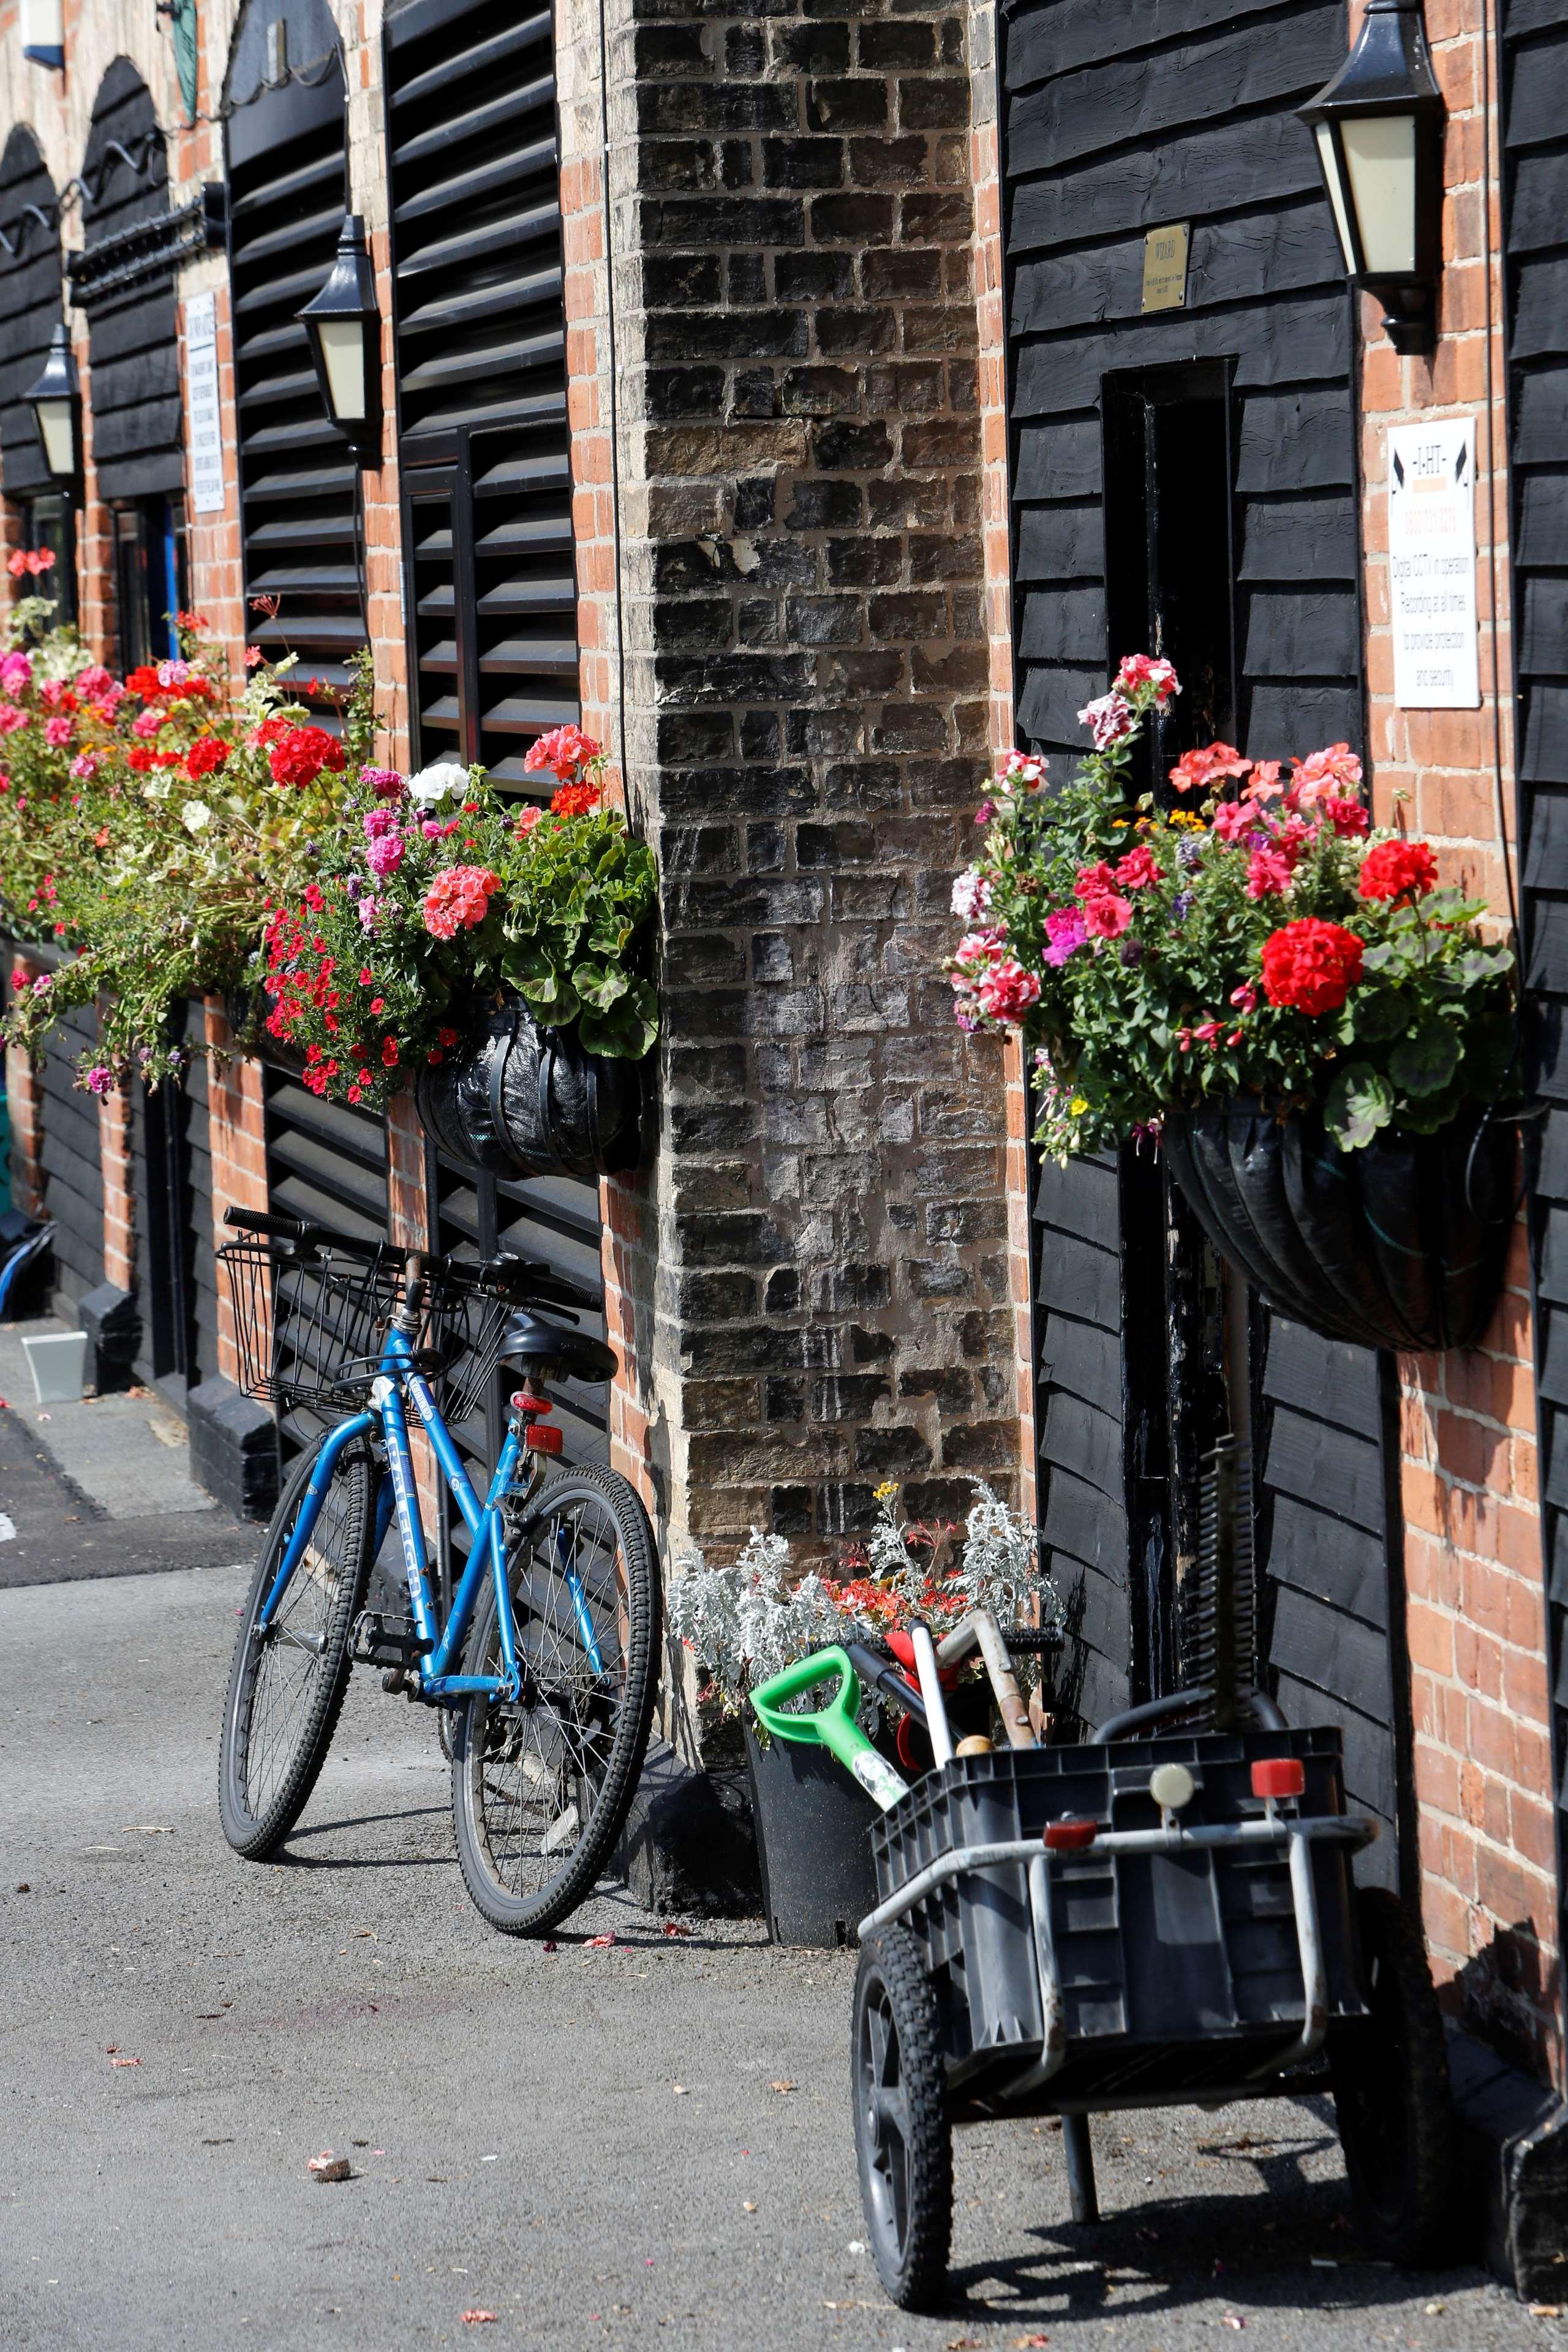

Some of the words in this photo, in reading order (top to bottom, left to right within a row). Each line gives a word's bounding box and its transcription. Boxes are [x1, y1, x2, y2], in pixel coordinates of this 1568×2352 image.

[1392, 556, 1411, 584] Digital
[1414, 553, 1431, 576] CCTV
[1401, 590, 1431, 619] Recording
[1433, 592, 1440, 612] at
[1403, 630, 1410, 649] to
[1411, 628, 1433, 655] provide
[1434, 628, 1464, 654] protection
[1417, 666, 1428, 686] and
[1429, 664, 1454, 692] security
[388, 1442, 420, 1593] RALEIGH
